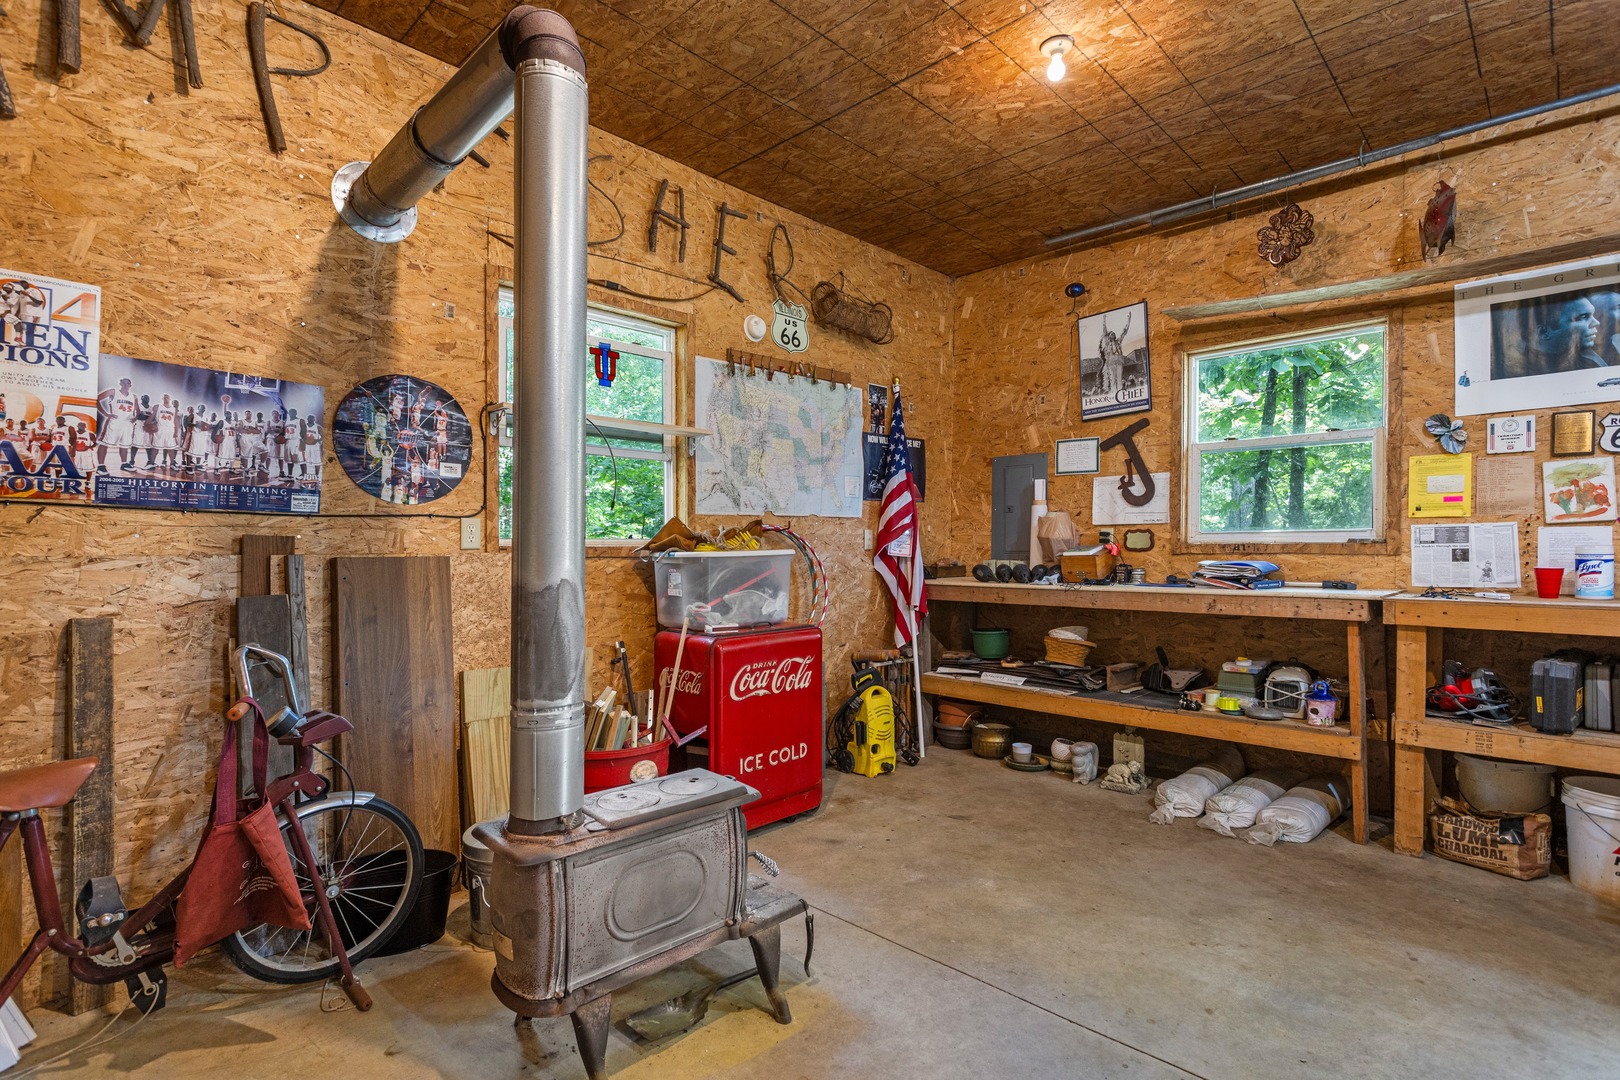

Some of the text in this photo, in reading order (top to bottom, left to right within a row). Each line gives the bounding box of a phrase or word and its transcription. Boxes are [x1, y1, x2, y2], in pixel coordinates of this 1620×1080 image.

[1460, 282, 1522, 300] THE
[784, 319, 798, 328] US
[781, 327, 801, 348] 66
[1085, 396, 1110, 406] HONOR
[1611, 417, 1620, 425] R
[0, 476, 86, 495] OUR
[99, 476, 125, 484] 2004-2005
[128, 479, 186, 489] HISTORY
[193, 482, 206, 490] IN
[213, 484, 235, 492] THE
[241, 486, 287, 496] MAKING
[1579, 561, 1603, 573] Lysol
[752, 660, 778, 670] DRINK
[730, 655, 815, 702] Coca-Cola
[740, 742, 808, 775] ICE COLD
[1438, 838, 1508, 862] CHARCOAL
